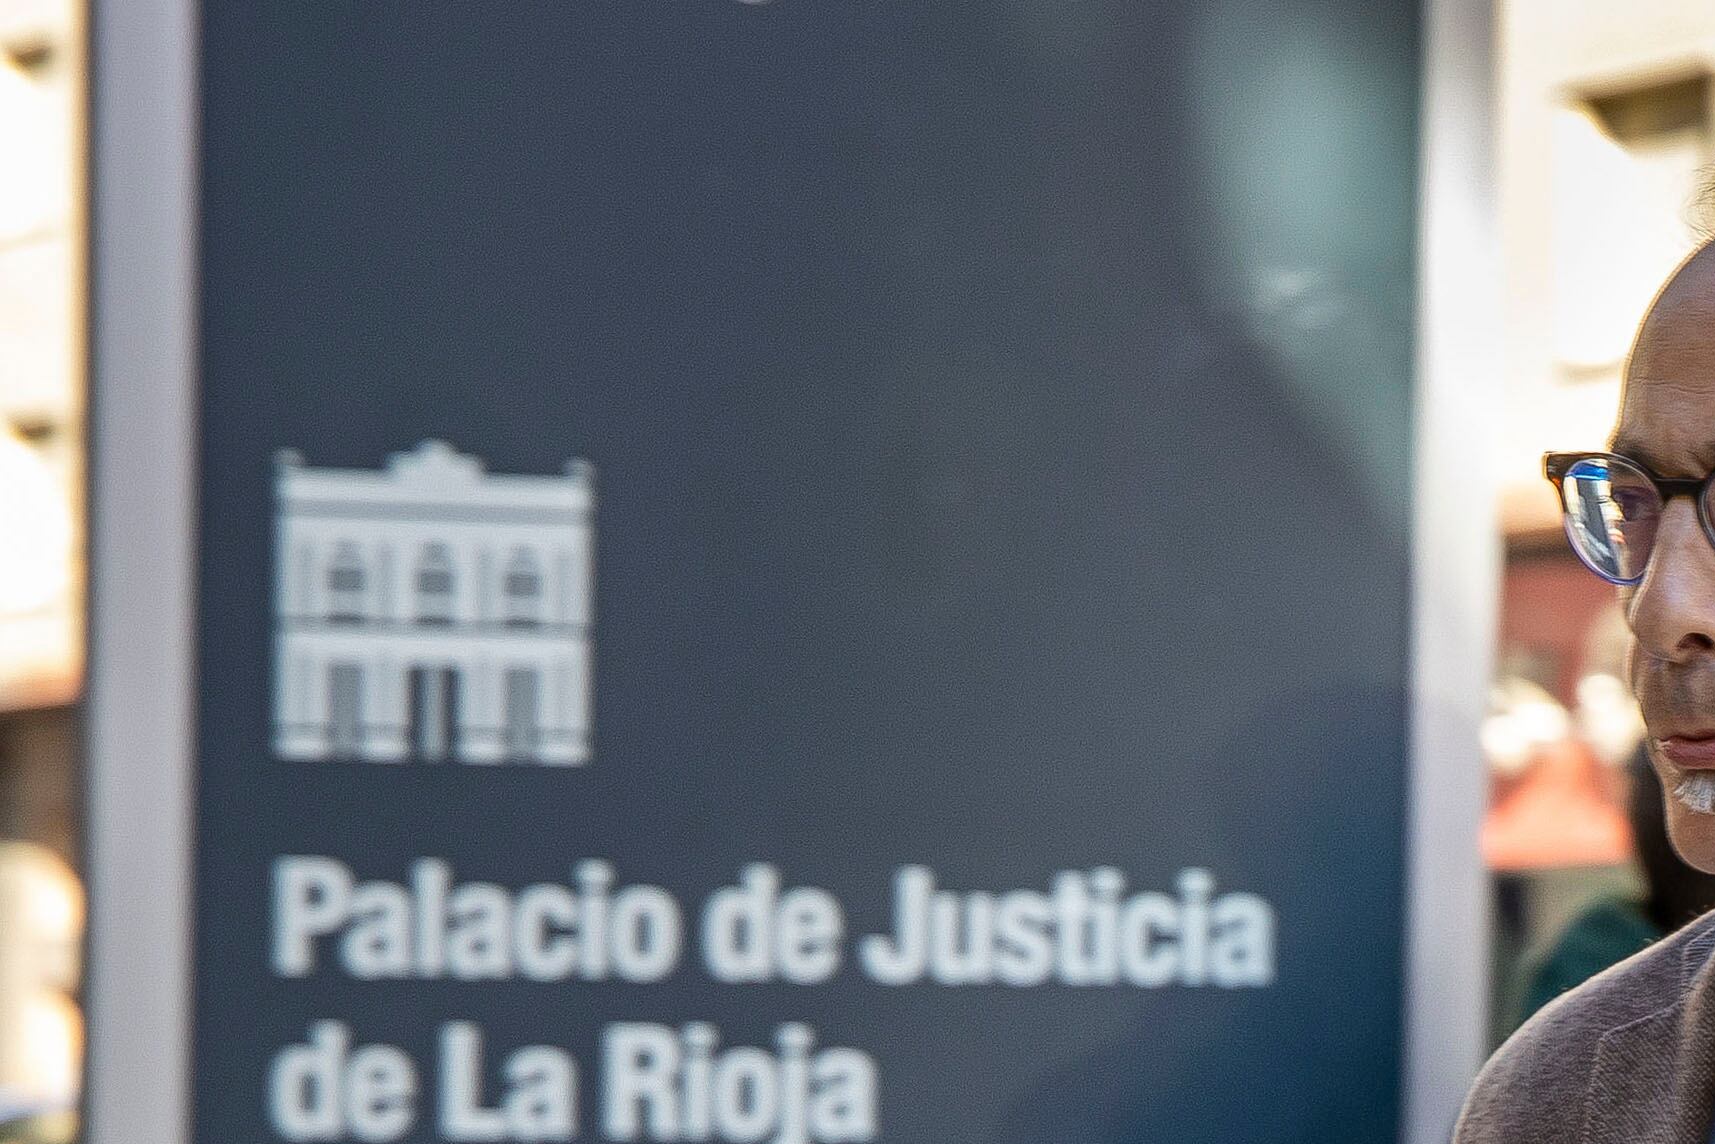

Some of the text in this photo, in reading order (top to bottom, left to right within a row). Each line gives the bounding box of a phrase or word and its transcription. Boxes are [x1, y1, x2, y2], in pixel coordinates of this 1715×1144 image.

[274, 857, 1274, 988] Palacio de Justicia
[270, 1020, 415, 1142] de
[440, 1021, 577, 1142] La
